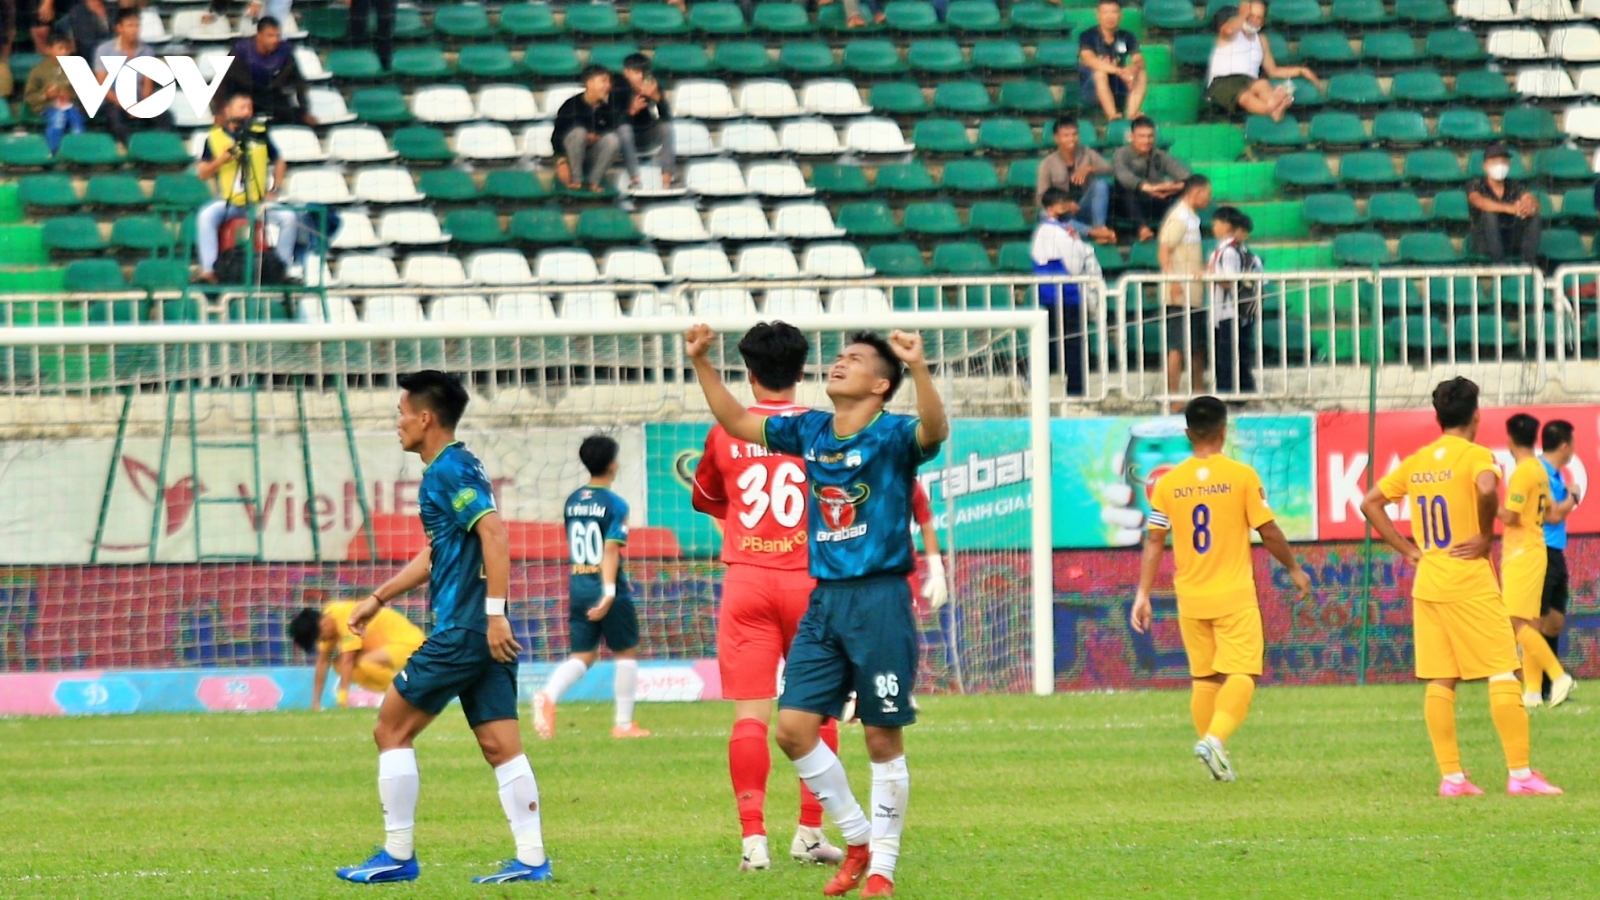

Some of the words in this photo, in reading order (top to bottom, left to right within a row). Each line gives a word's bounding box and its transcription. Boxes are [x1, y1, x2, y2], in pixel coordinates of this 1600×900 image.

[737, 462, 806, 529] 36
[914, 449, 1033, 502] raba
[1174, 487, 1194, 498] DUY
[1198, 484, 1231, 496] THANH
[955, 501, 994, 527] ANH
[995, 496, 1025, 516] GIA
[1192, 503, 1211, 554] 8
[1417, 495, 1452, 550] 10
[571, 521, 604, 565] 60
[875, 673, 900, 698] 86
